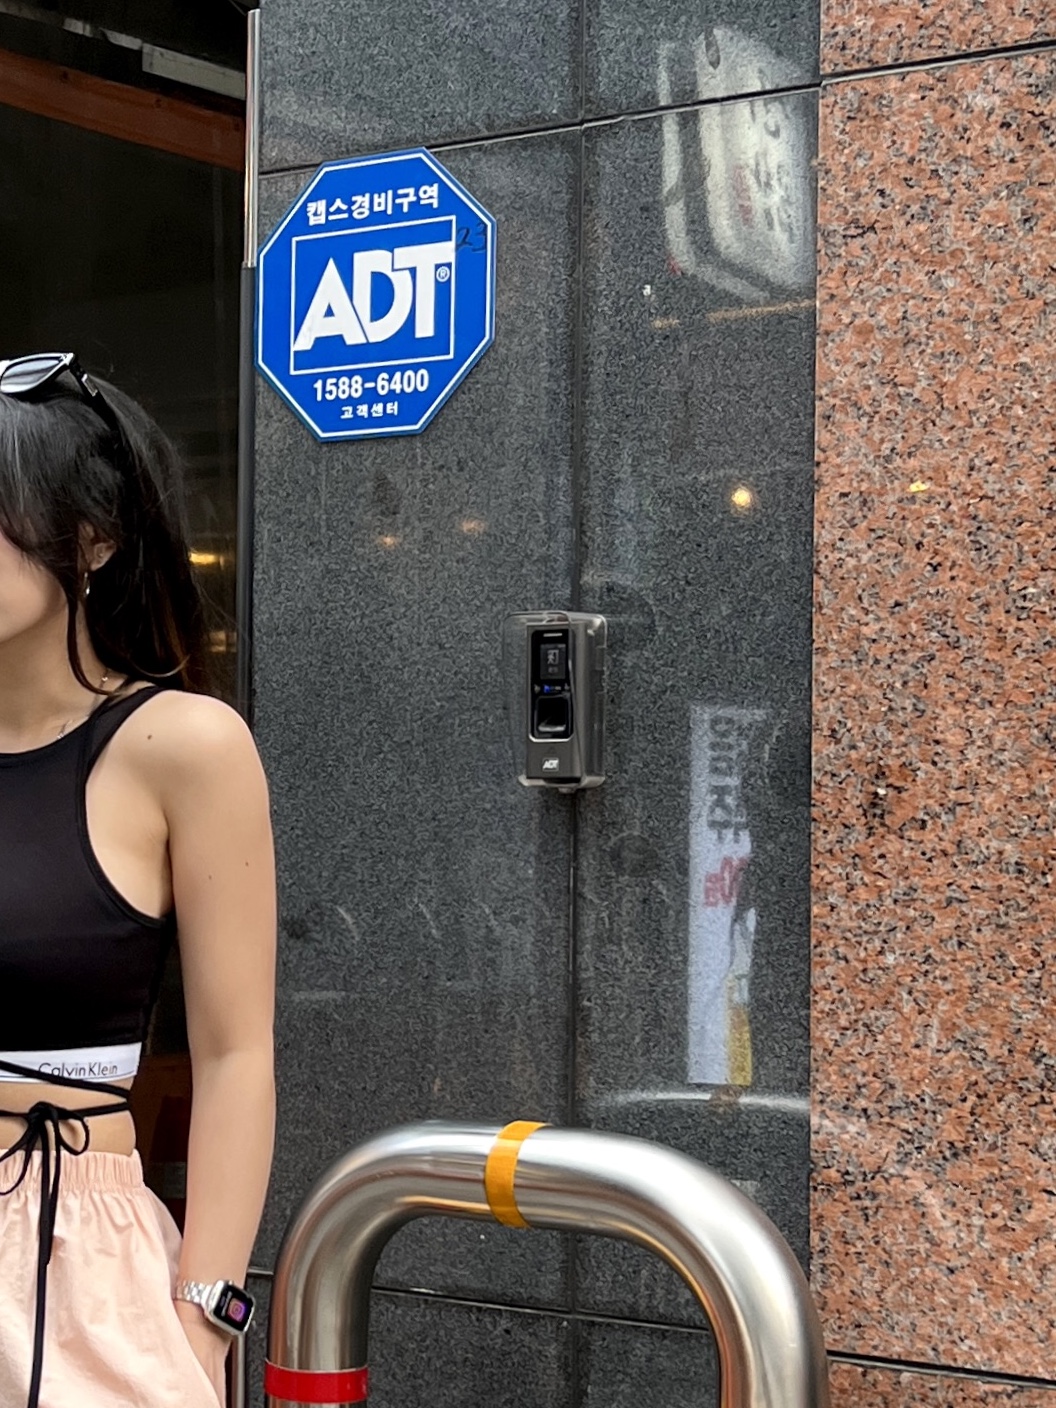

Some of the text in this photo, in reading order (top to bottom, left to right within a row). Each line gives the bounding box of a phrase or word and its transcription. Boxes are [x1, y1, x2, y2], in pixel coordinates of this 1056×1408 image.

[305, 182, 440, 226] 캡스경비구역
[312, 368, 430, 402] 1588-6400
[339, 402, 399, 419] 고객센터
